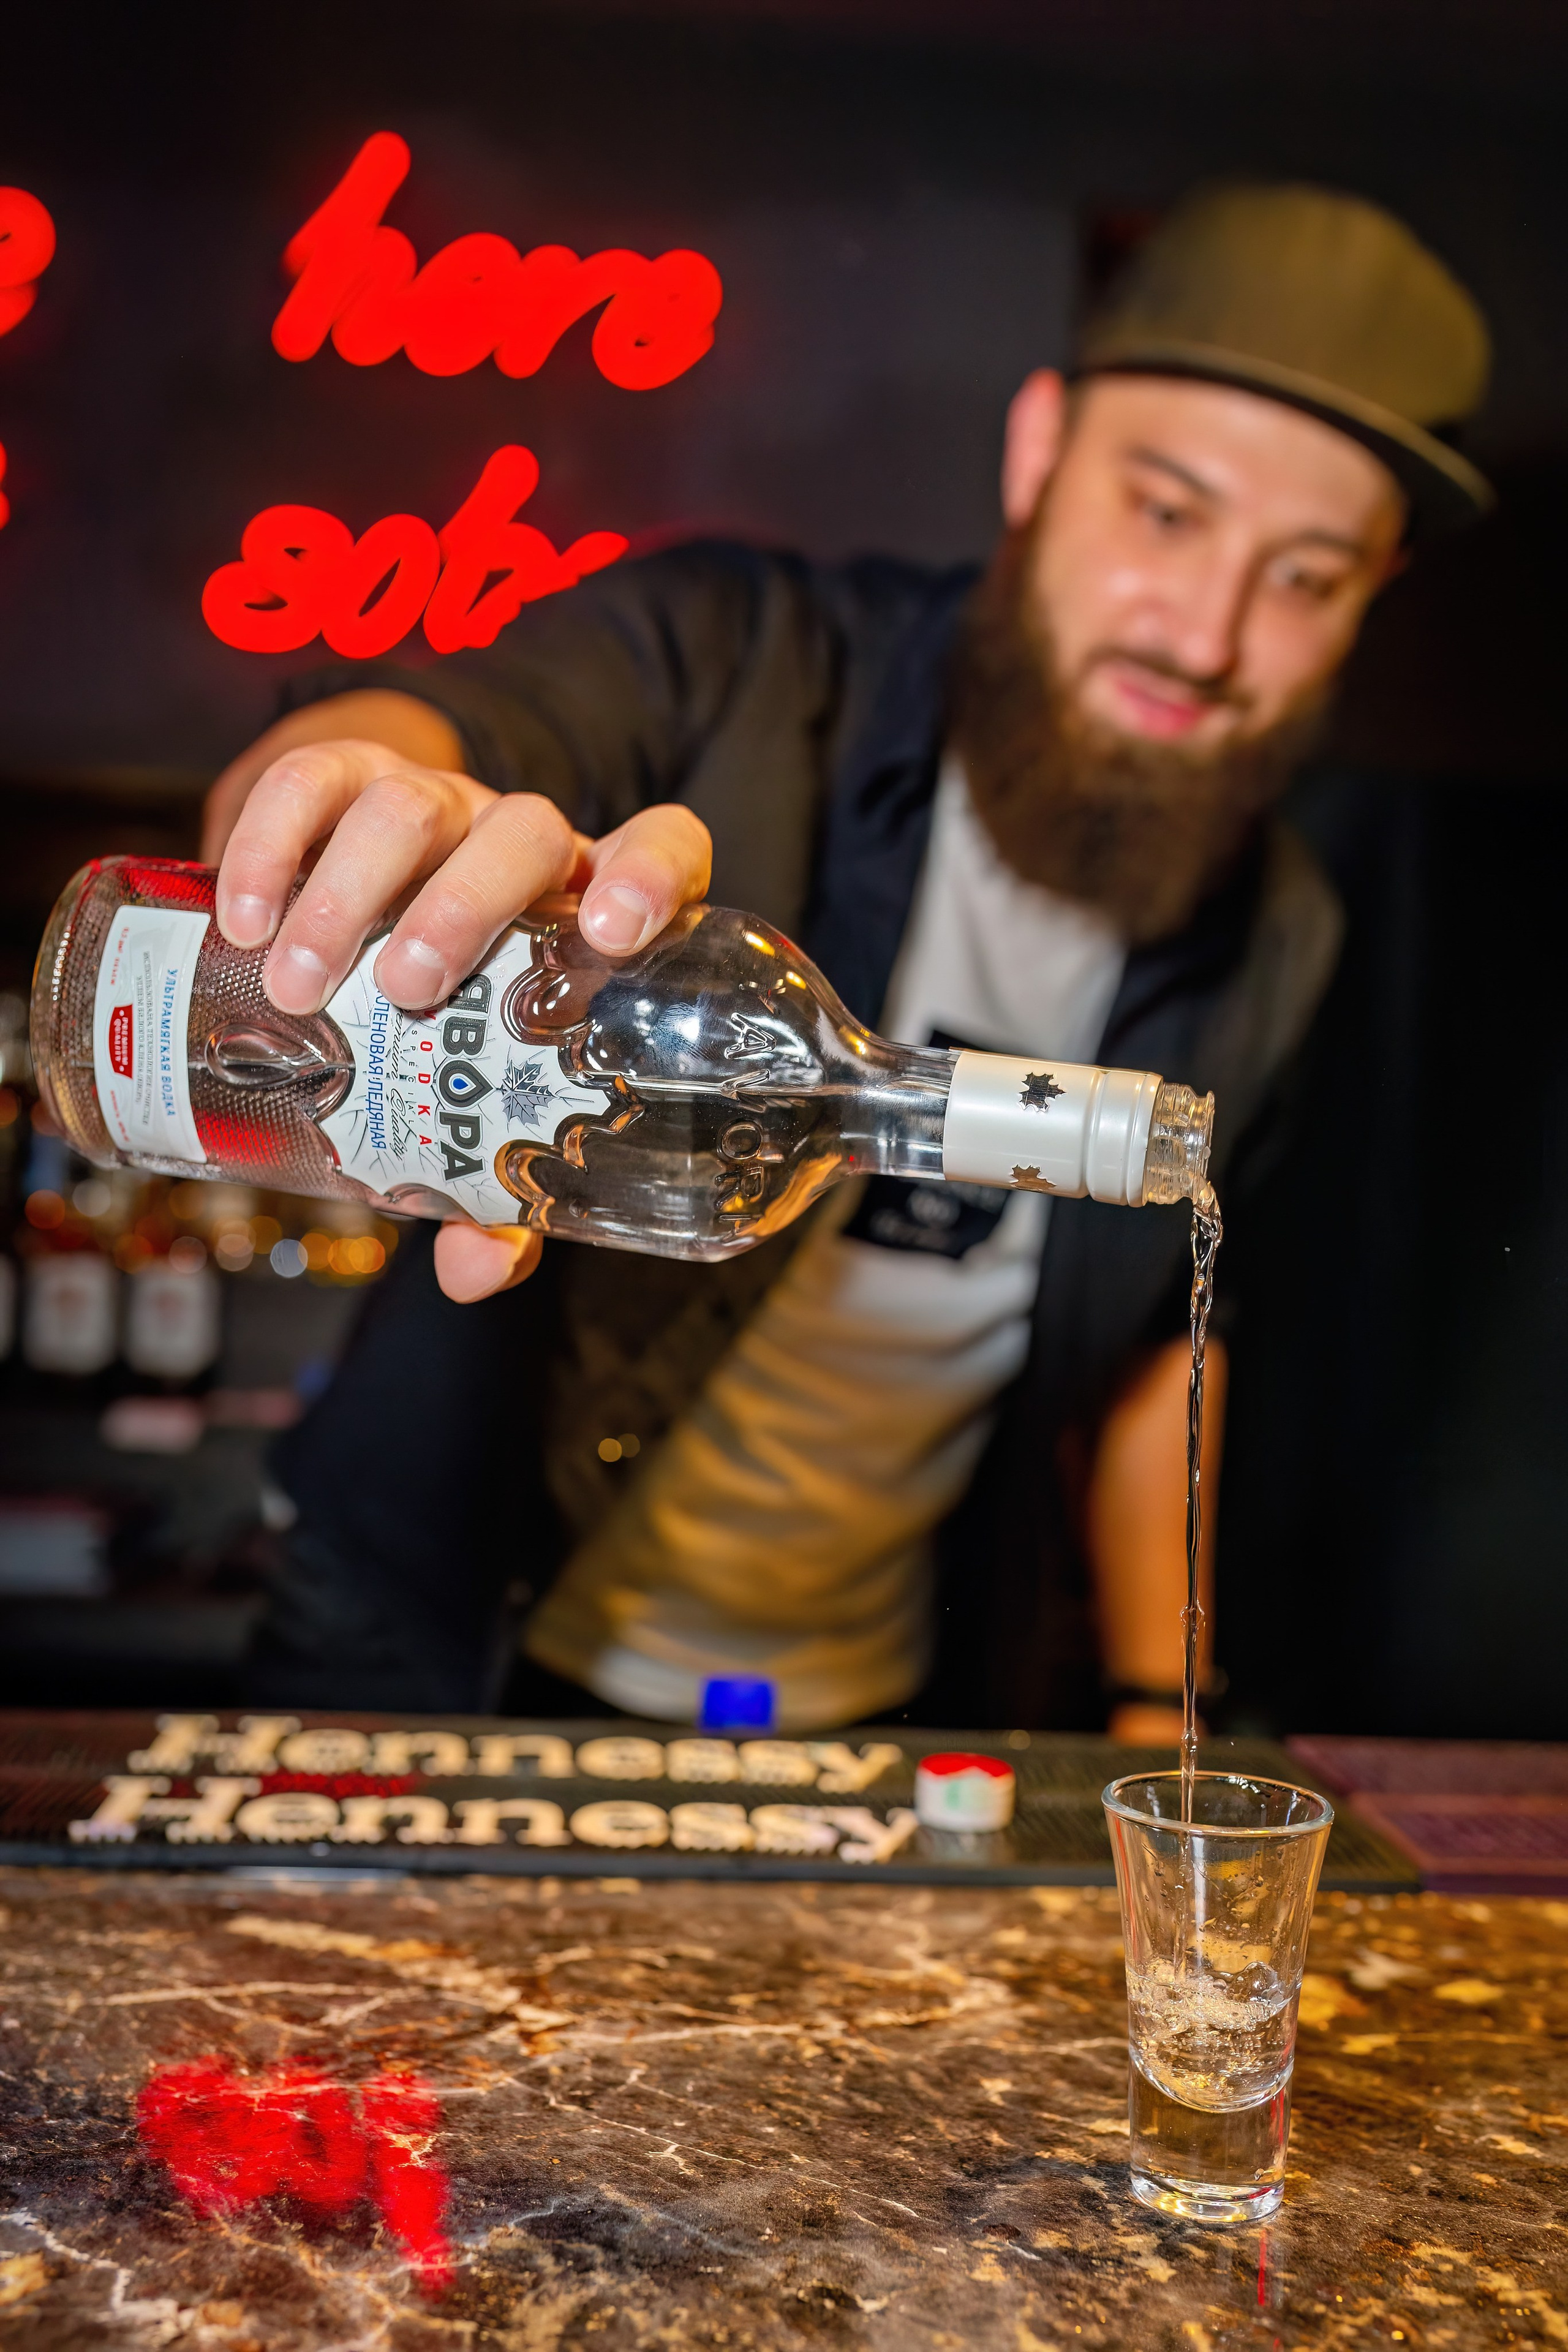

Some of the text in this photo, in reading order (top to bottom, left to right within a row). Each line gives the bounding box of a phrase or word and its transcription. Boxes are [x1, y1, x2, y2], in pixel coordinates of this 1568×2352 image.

[113, 1018, 122, 1062] QUALITY
[160, 968, 178, 1116] УЛЬТРАМЯГКАЯ ВОДКА
[407, 1030, 418, 1125] SPECIAL
[418, 1010, 438, 1145] VODKA
[437, 973, 495, 1181] ЯВОРА
[366, 1079, 386, 1150] ЛЕДЯНАЯ
[390, 1088, 408, 1161] Quality
[127, 1714, 902, 1794] Hennessy
[68, 1776, 919, 1864] Hennessy
